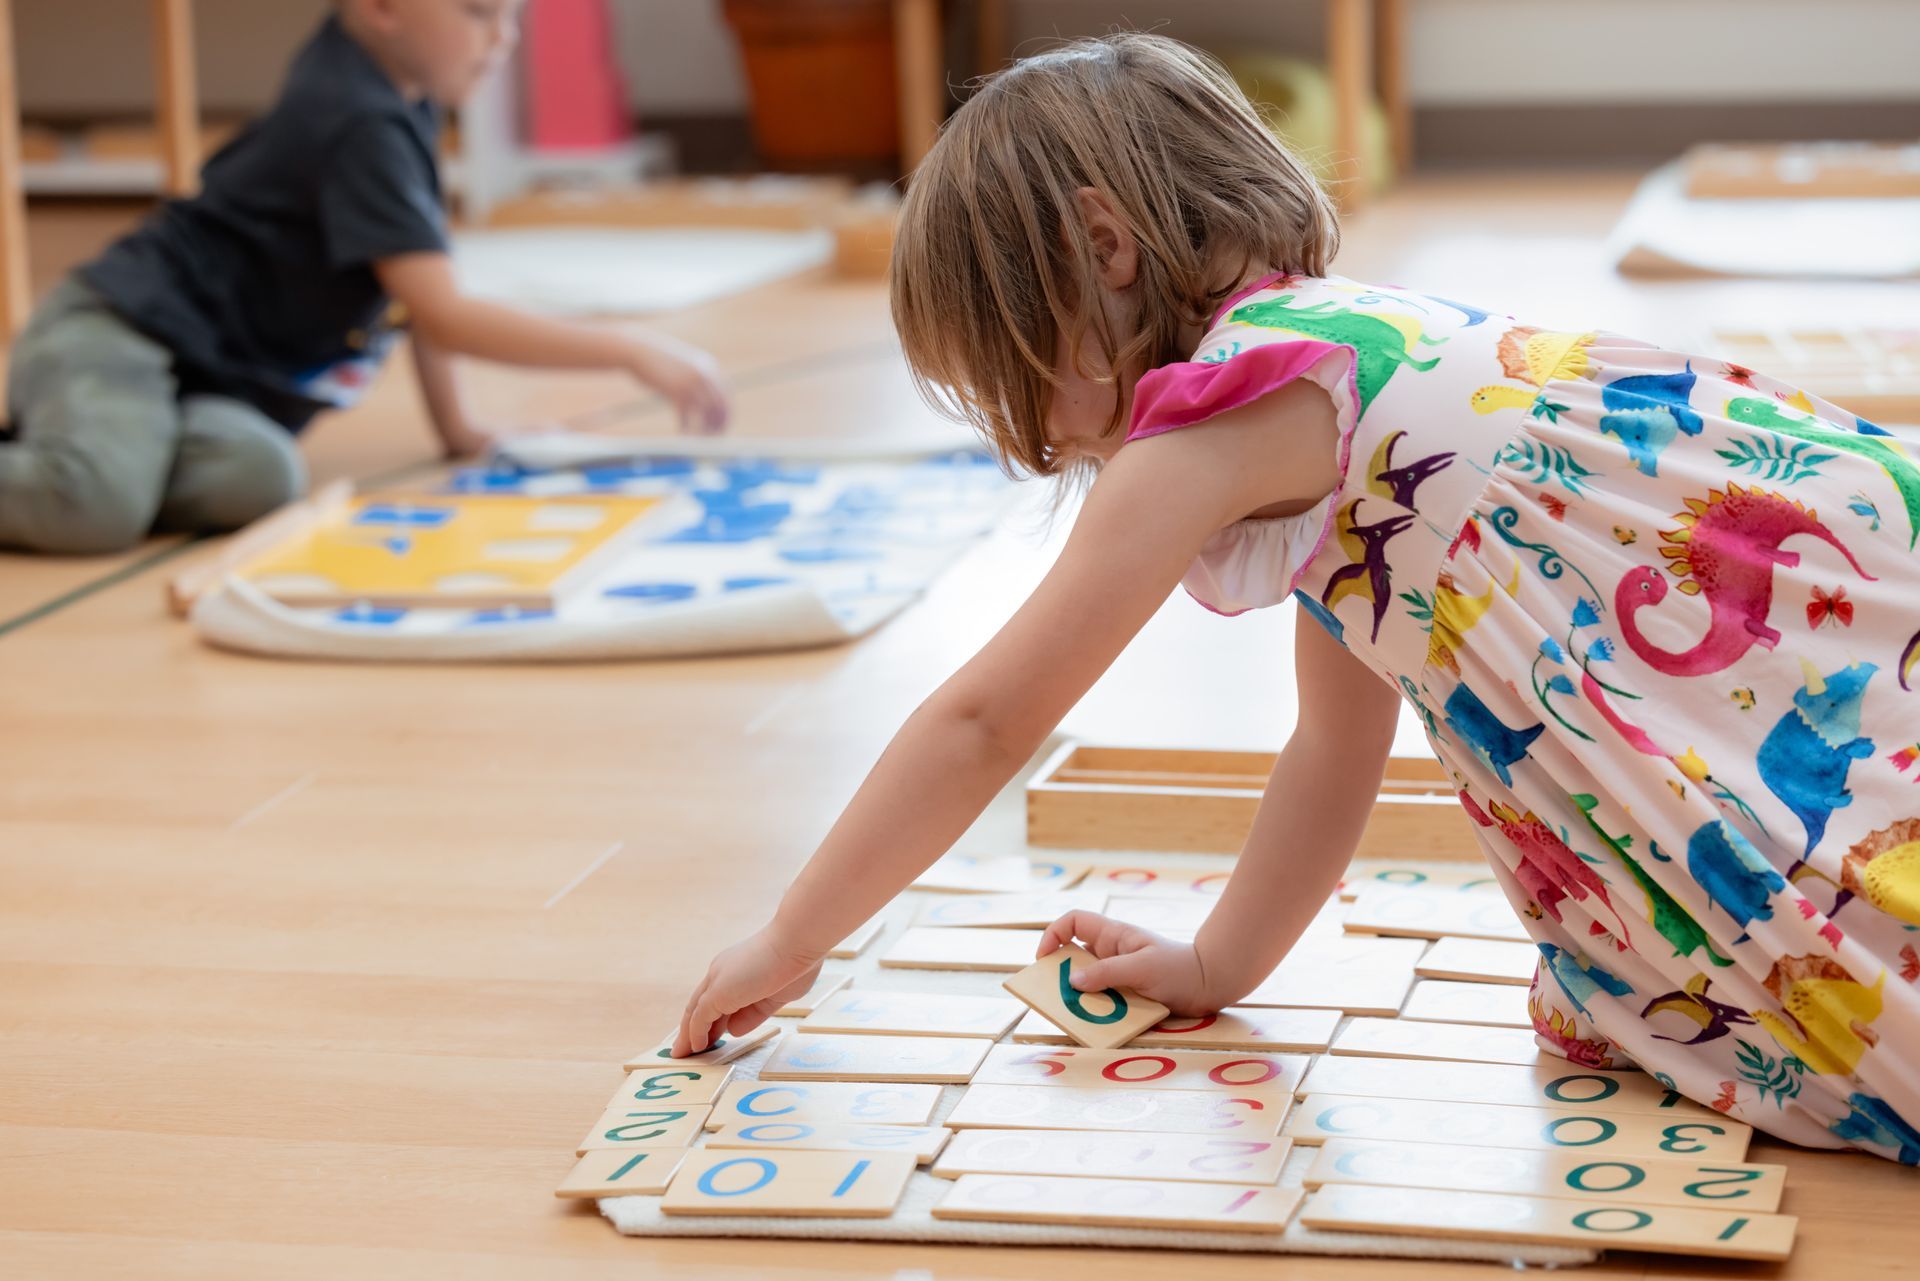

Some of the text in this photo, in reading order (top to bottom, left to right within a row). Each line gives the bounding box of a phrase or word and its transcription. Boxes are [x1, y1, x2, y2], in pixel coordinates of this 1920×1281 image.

[634, 1072, 702, 1100] 3
[604, 1111, 688, 1141] 2
[606, 1154, 649, 1181] 1
[697, 1158, 871, 1197] 10
